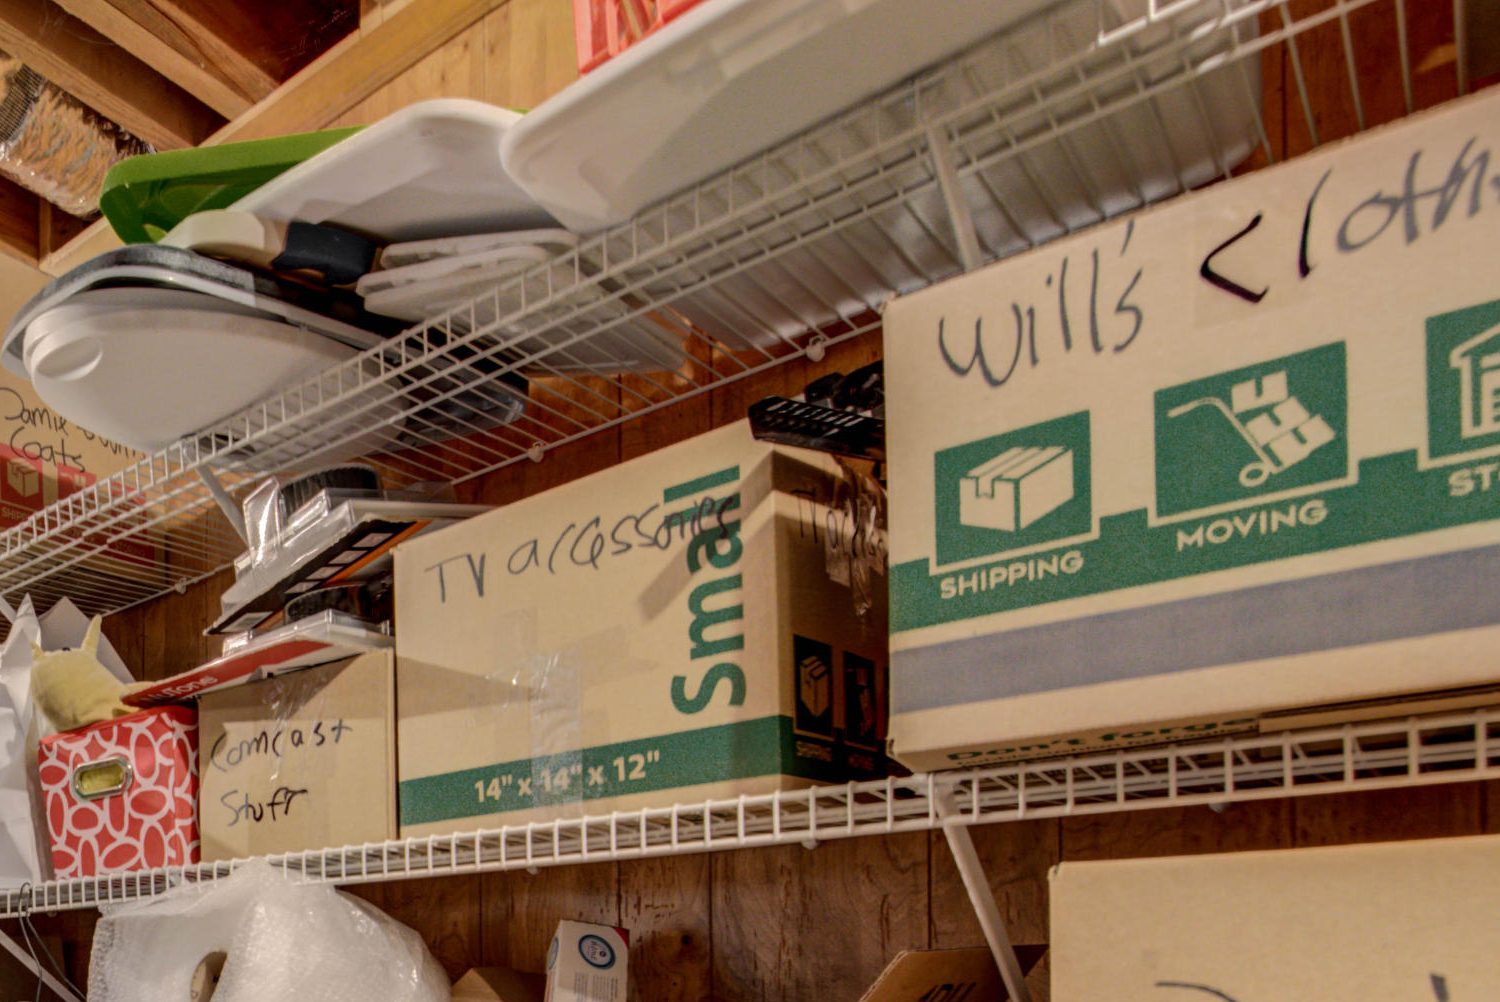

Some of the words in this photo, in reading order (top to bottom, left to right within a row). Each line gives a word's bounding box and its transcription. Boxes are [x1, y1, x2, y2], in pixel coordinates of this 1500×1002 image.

[10, 426, 86, 473] Coats
[1177, 500, 1329, 552] MOVING
[426, 554, 486, 603] TV
[663, 465, 747, 716] Small
[940, 550, 1084, 600] SHIPPING
[474, 774, 513, 804] 14"
[517, 779, 533, 796] x
[540, 763, 583, 793] 14"
[589, 765, 605, 787] x
[613, 750, 660, 783] 12"
